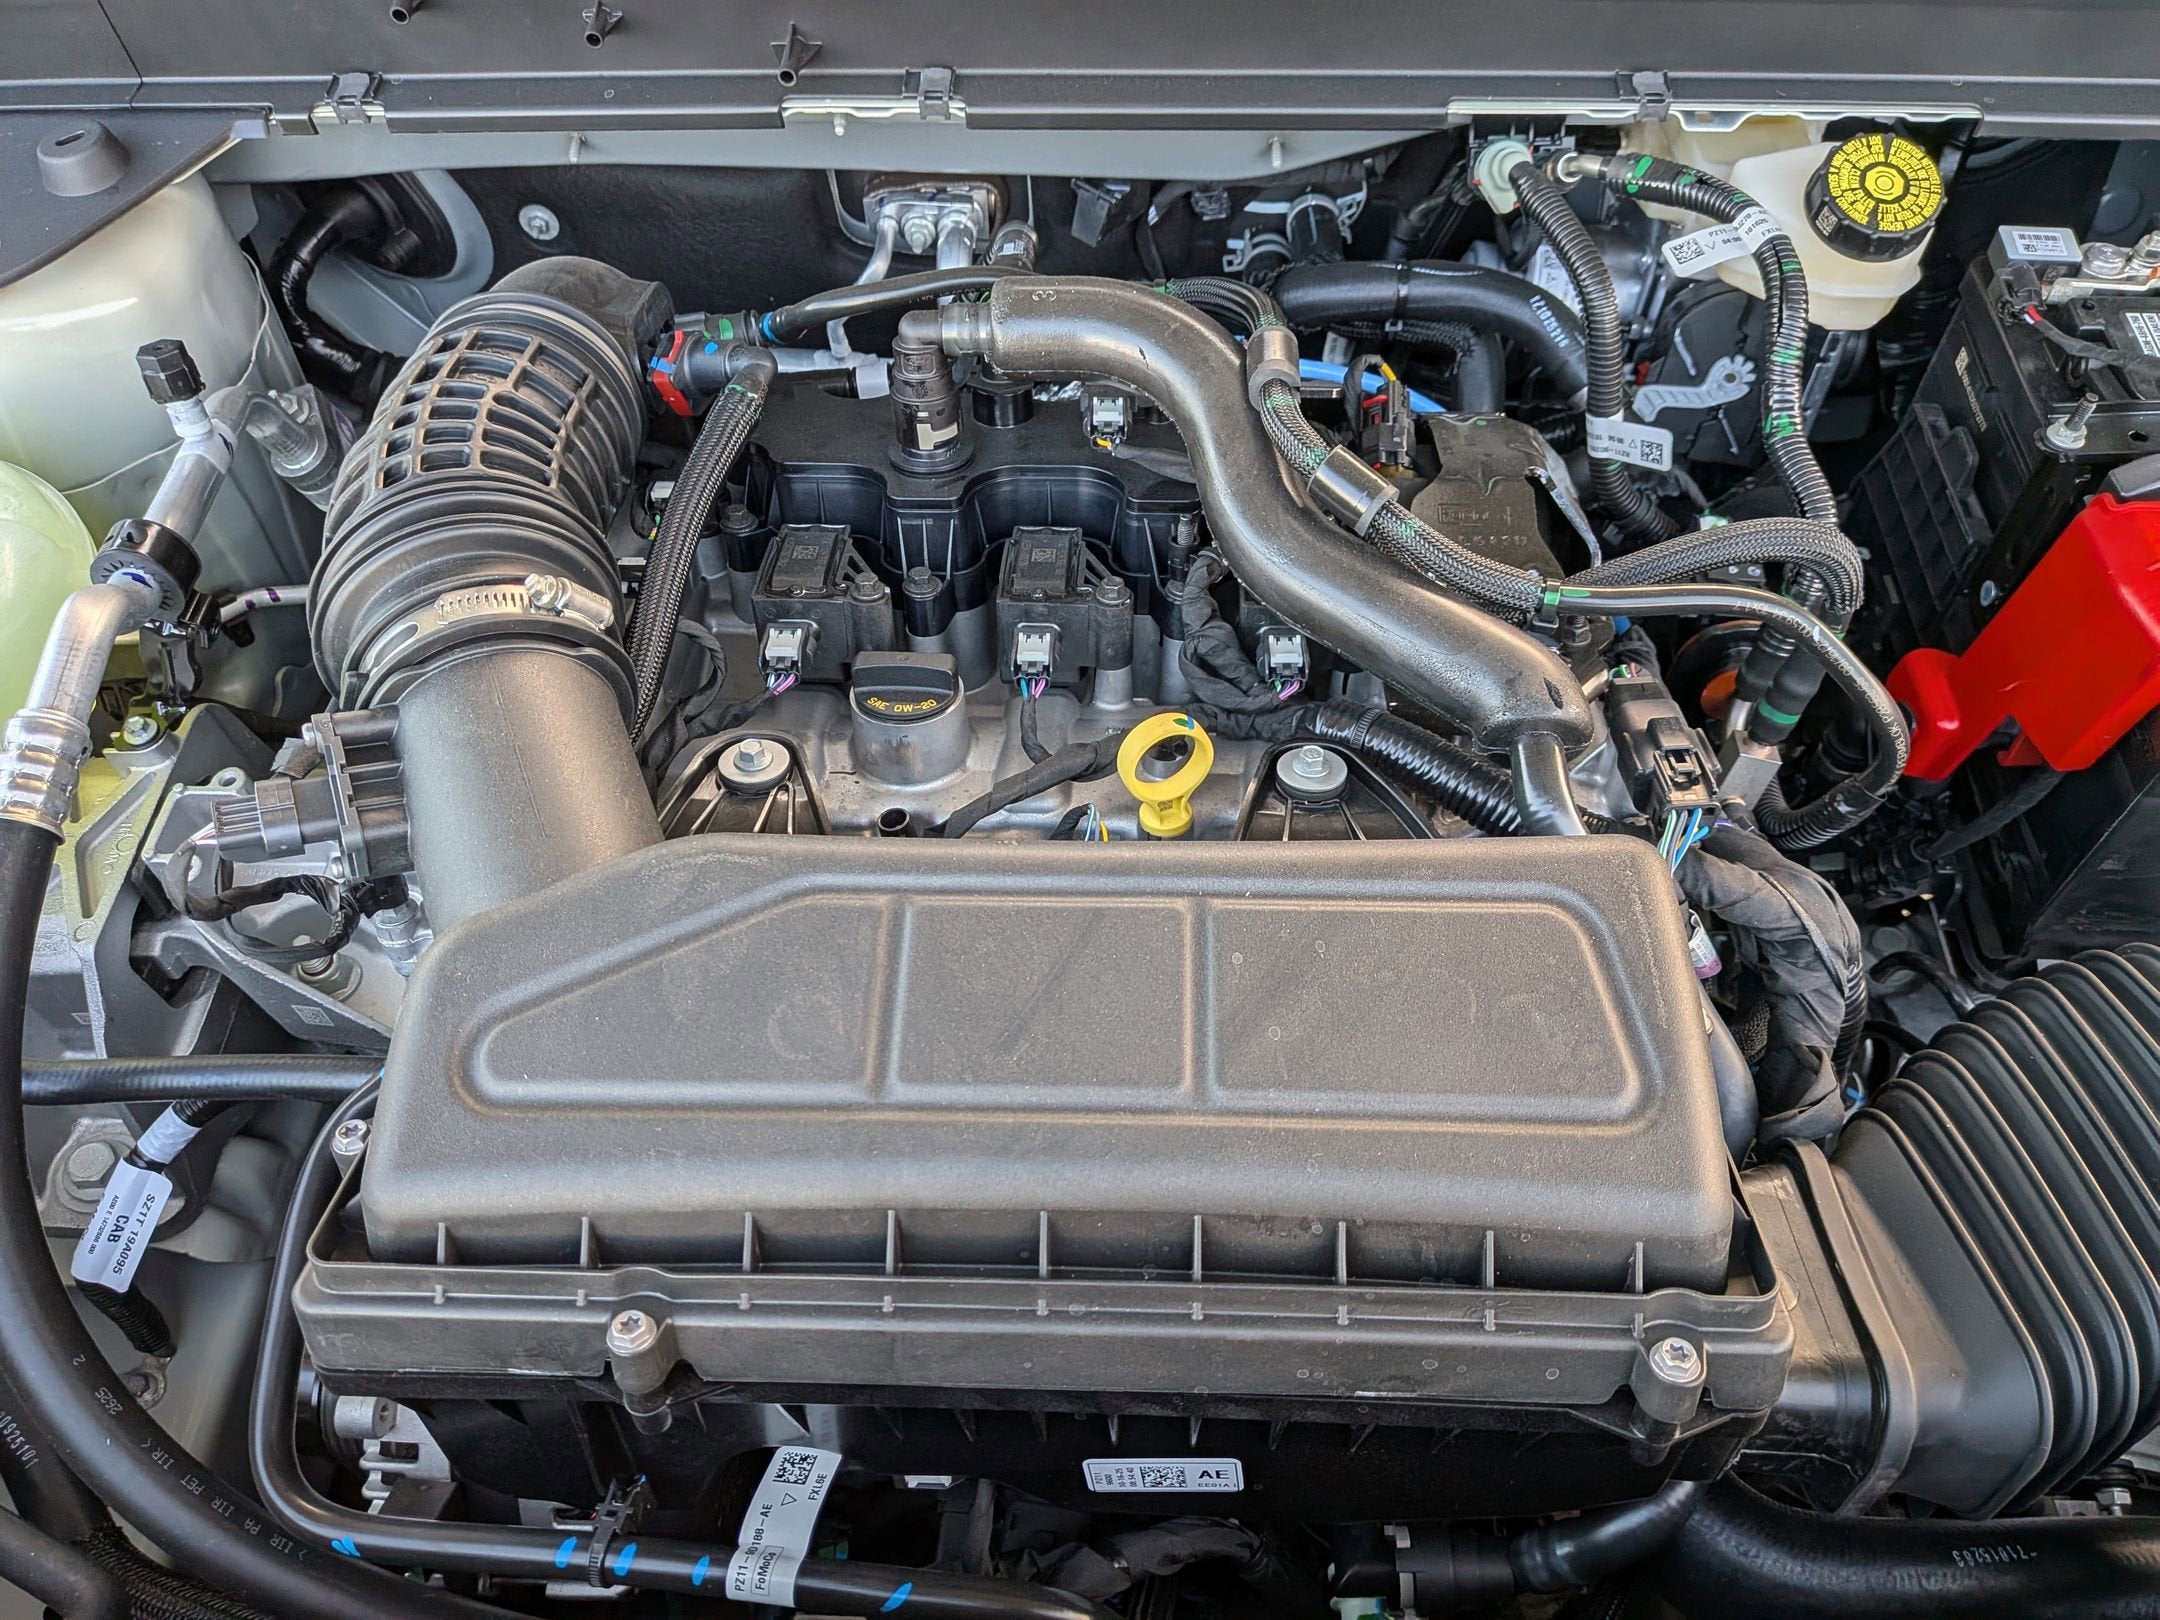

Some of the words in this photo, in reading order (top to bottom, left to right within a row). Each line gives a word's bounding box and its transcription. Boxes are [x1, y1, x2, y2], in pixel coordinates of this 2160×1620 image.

[1841, 138, 1862, 154] FLUID
[1867, 135, 1881, 144] DOT
[1869, 144, 1882, 153] CAP
[1830, 150, 1847, 167] FROM
[1846, 146, 1870, 163] BEFORE
[1828, 173, 1842, 196] SEALED
[1849, 167, 1861, 188] CLEAN
[1842, 190, 1856, 203] USE
[1930, 185, 1941, 193] LE
[1834, 196, 1868, 225] CONTAINER
[867, 697, 890, 710] SAE
[894, 699, 937, 712] 0W-20
[136, 1194, 156, 1227] SZ1T
[107, 1214, 130, 1243] CAB
[113, 1230, 139, 1275] 19A095
[152, 1447, 174, 1470] IIR
[180, 1474, 204, 1496] PET
[1198, 1470, 1230, 1480] AE
[808, 1473, 828, 1500] FXL6E
[210, 1496, 235, 1518] IIR
[243, 1518, 262, 1536] PA
[270, 1534, 294, 1554] IIR
[755, 1551, 776, 1590] FoMoCo
